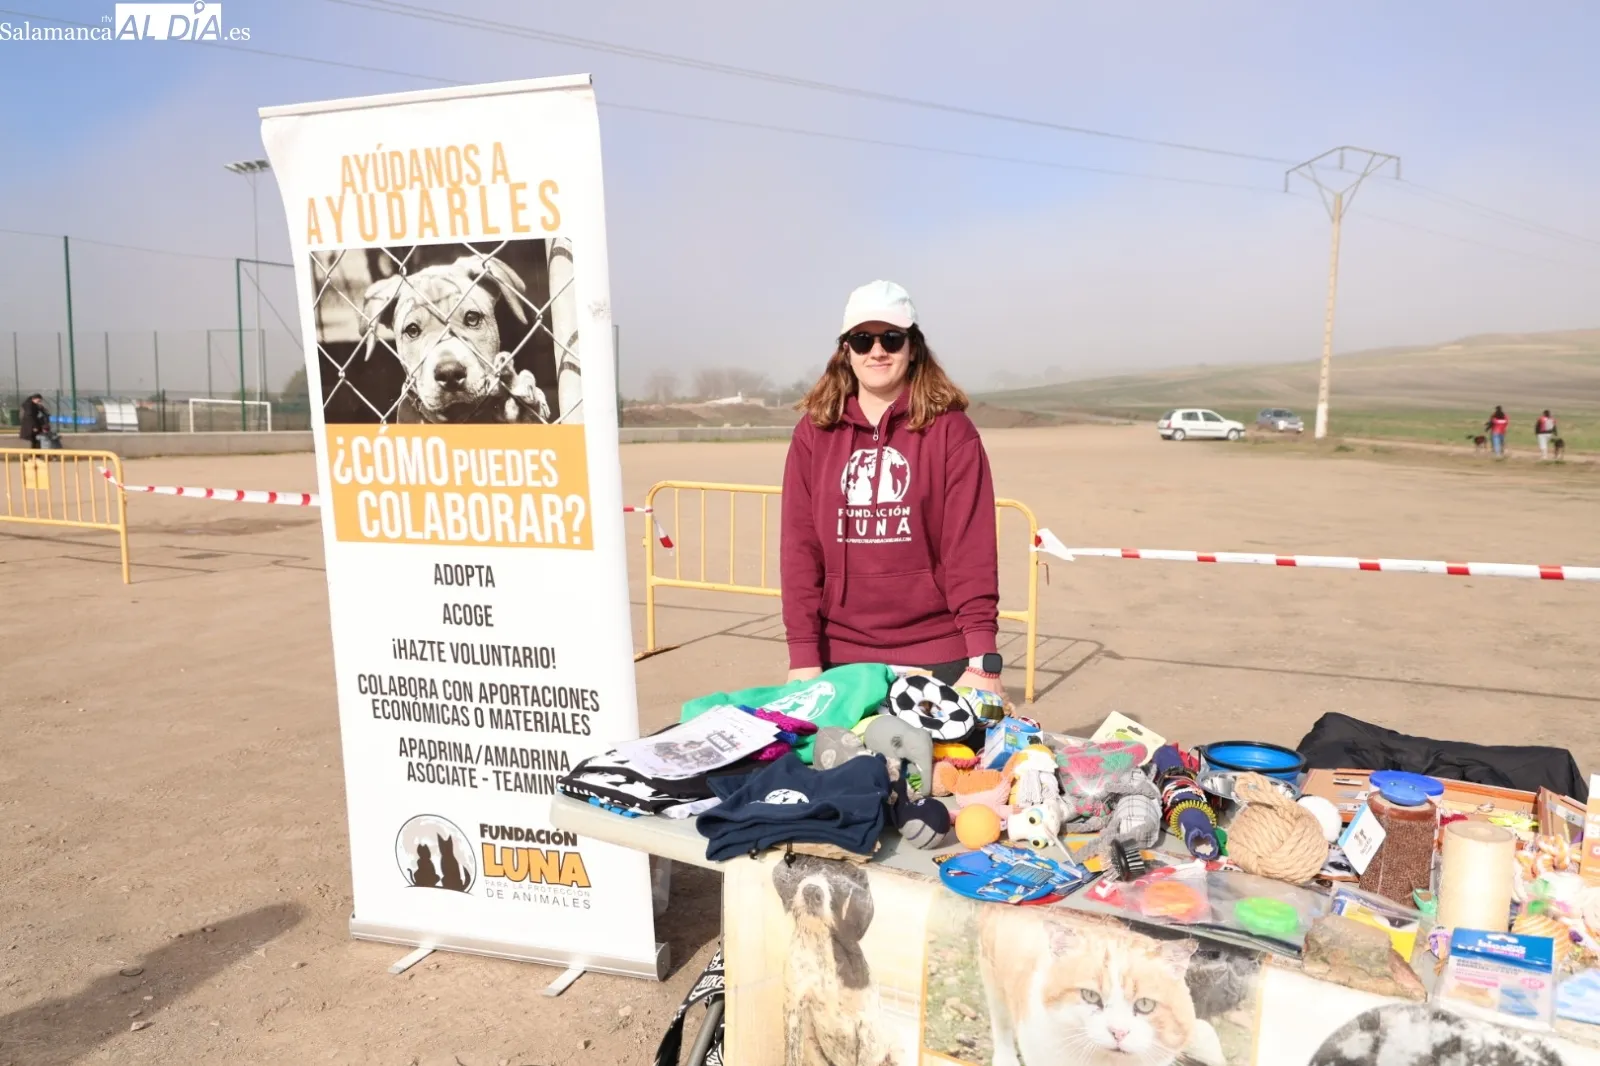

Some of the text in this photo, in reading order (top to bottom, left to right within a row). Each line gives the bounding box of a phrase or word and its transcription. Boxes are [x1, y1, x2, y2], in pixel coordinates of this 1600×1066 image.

[341, 141, 511, 195] AYÚDANOS A
[307, 179, 562, 245] AYUDARLES
[333, 425, 560, 488] ¿CÓMO PUEDES
[357, 490, 587, 545] COLABORAR?
[433, 563, 496, 588] ADOPTA
[442, 603, 495, 627] ACOGE
[391, 638, 557, 669] ¡HAZTE VOLUNTARIO!
[357, 673, 601, 712] COLABORA CON APORTACIONES
[371, 696, 592, 736] ECONÓMICAS O MATERIALES
[398, 736, 571, 772] APADRINA/AMADRINA
[406, 756, 478, 789] ASÓCIATE
[479, 823, 578, 847] FUNDACIÓN
[481, 842, 593, 889] LUNA
[485, 879, 509, 889] PARA
[486, 888, 592, 910] DE ANIMALES
